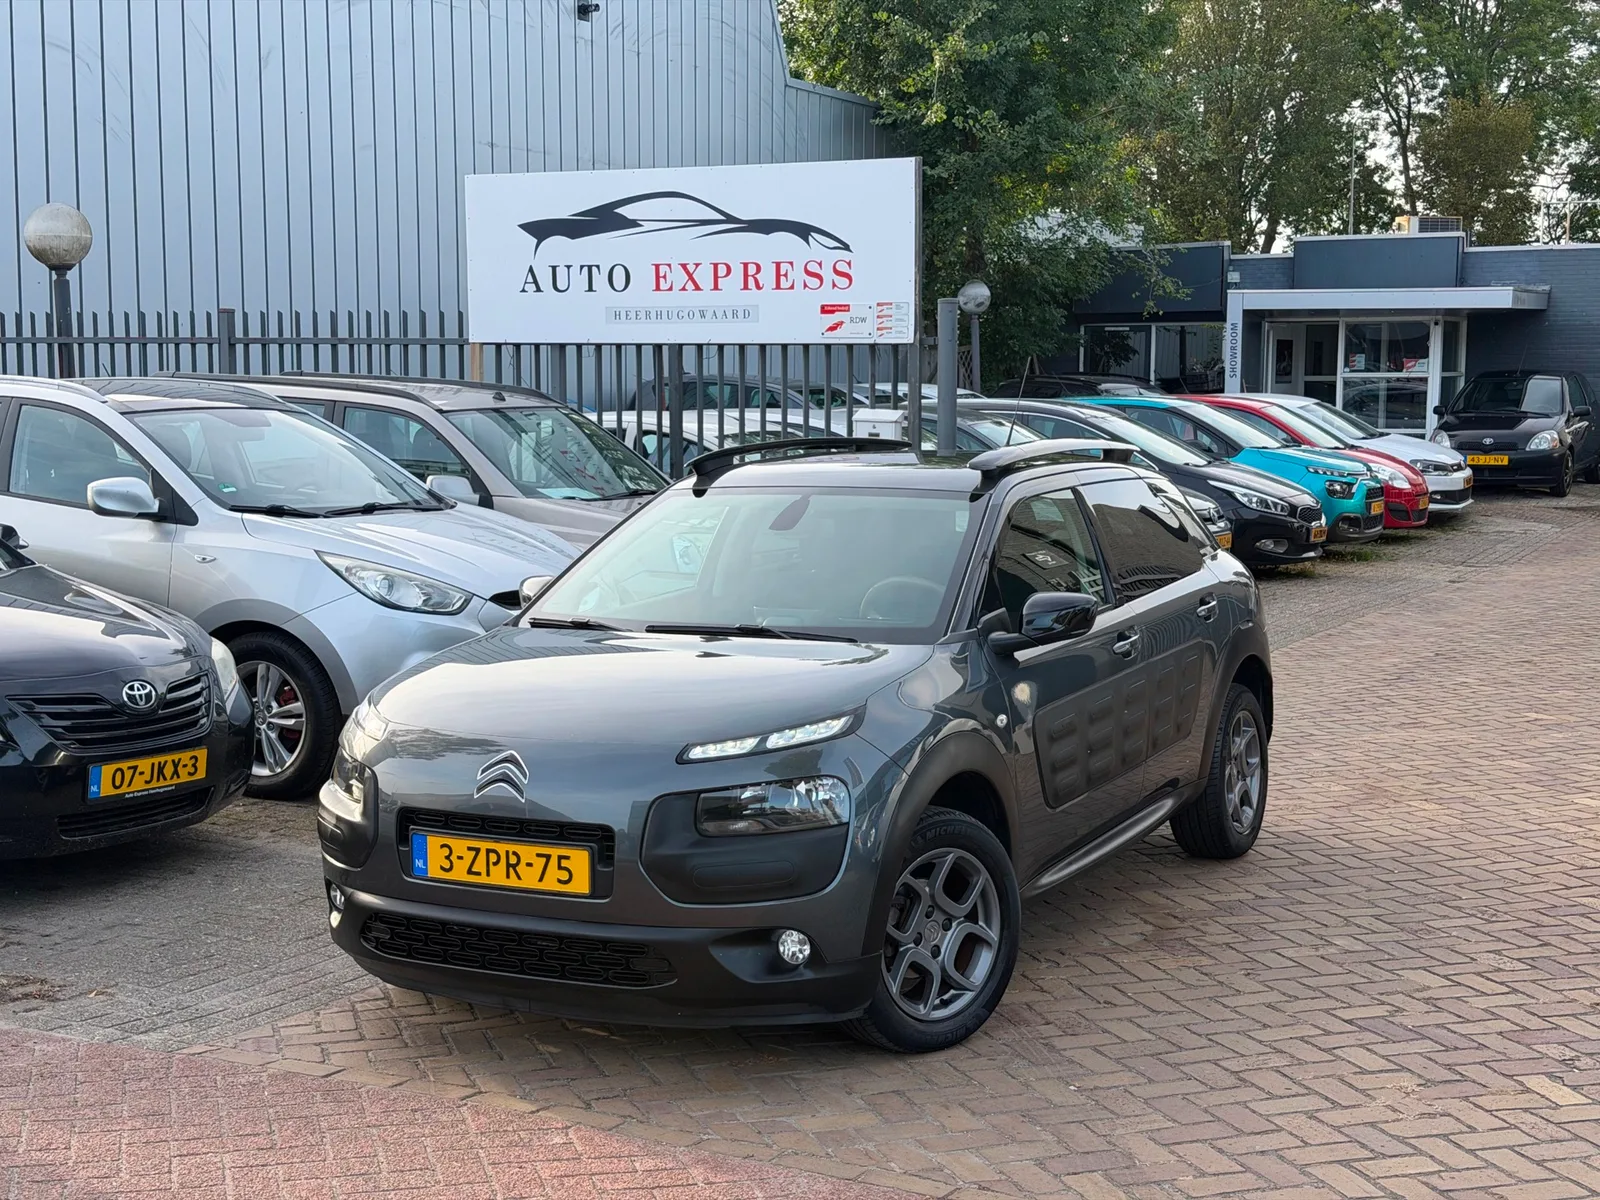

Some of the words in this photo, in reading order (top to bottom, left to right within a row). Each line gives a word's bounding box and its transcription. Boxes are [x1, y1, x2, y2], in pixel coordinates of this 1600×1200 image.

[519, 263, 631, 294] AUTO
[652, 259, 854, 293] EXPRESS
[614, 308, 751, 321] HEERHUGOWAARD
[1229, 322, 1239, 379] SHOWROOM
[1470, 456, 1505, 464] 43-JJ-NV
[111, 755, 199, 790] 07-JKX-3
[90, 784, 100, 793] NL
[415, 858, 426, 869] NL
[439, 843, 573, 885] 3-ZPR-75
